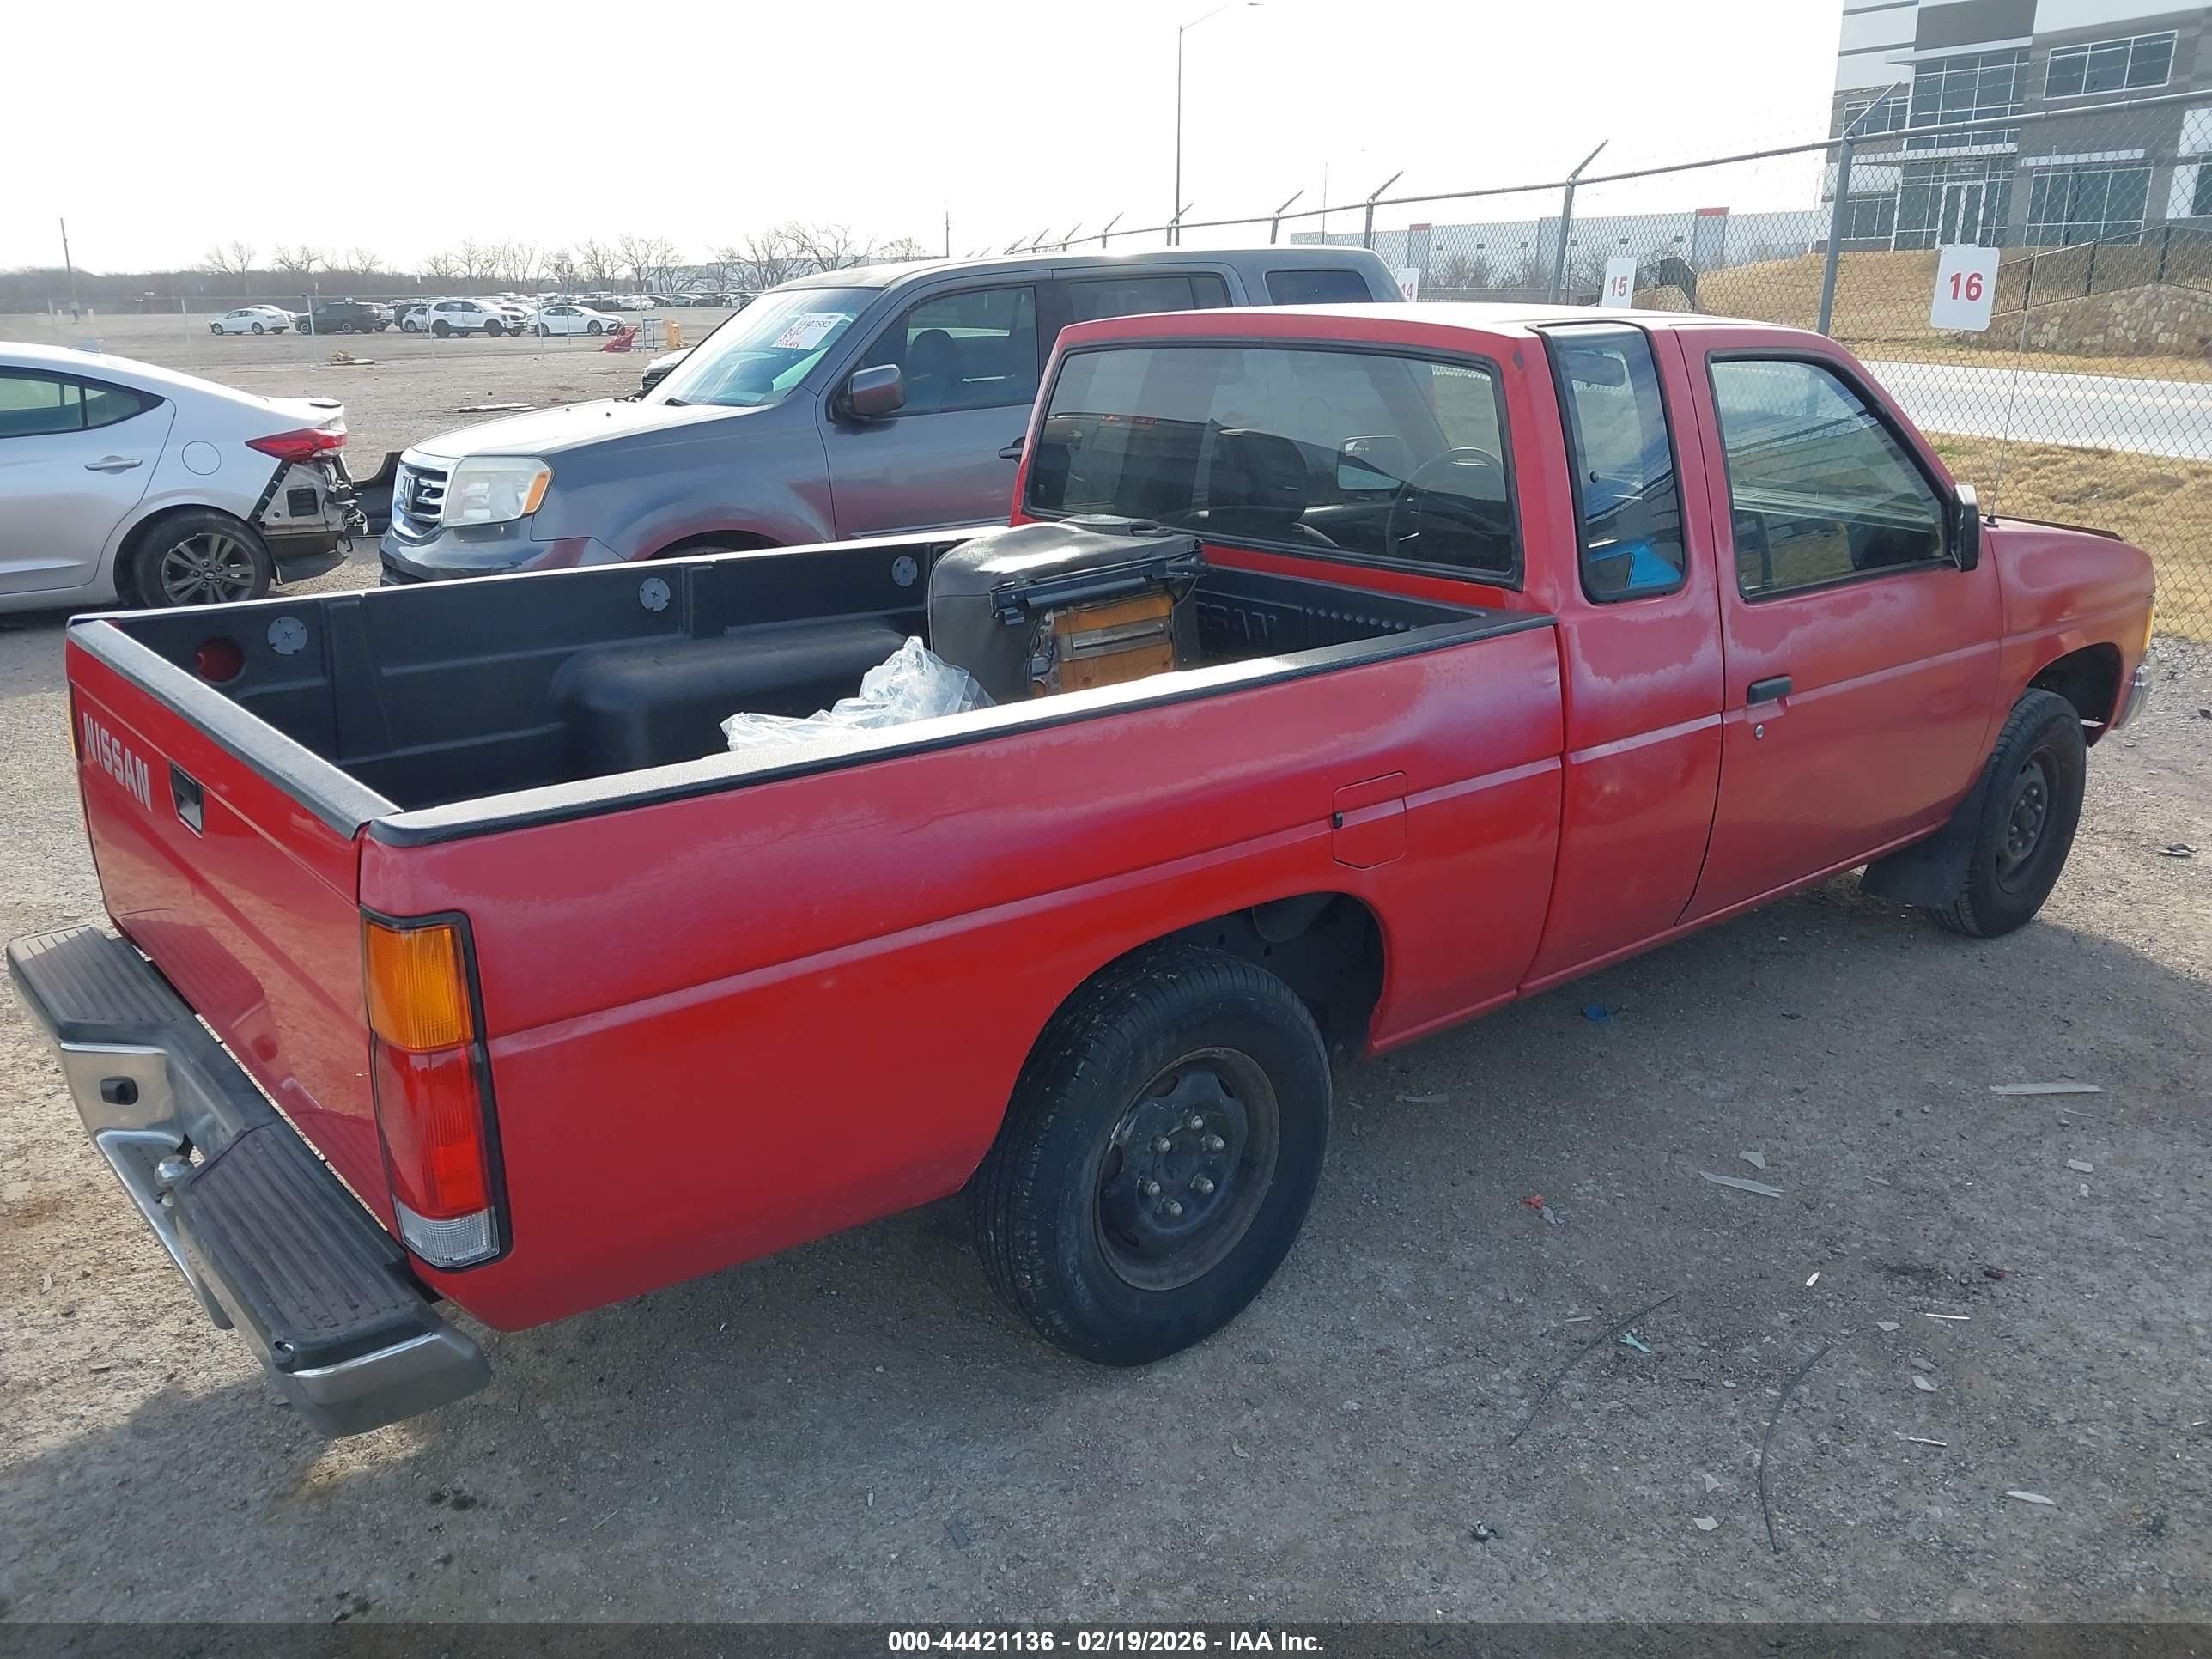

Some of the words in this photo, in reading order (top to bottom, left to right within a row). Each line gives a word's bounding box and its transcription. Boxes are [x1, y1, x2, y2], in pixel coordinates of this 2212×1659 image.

[1611, 276, 1629, 297] 15
[1948, 271, 1984, 302] 16
[82, 711, 152, 812] NISSAN
